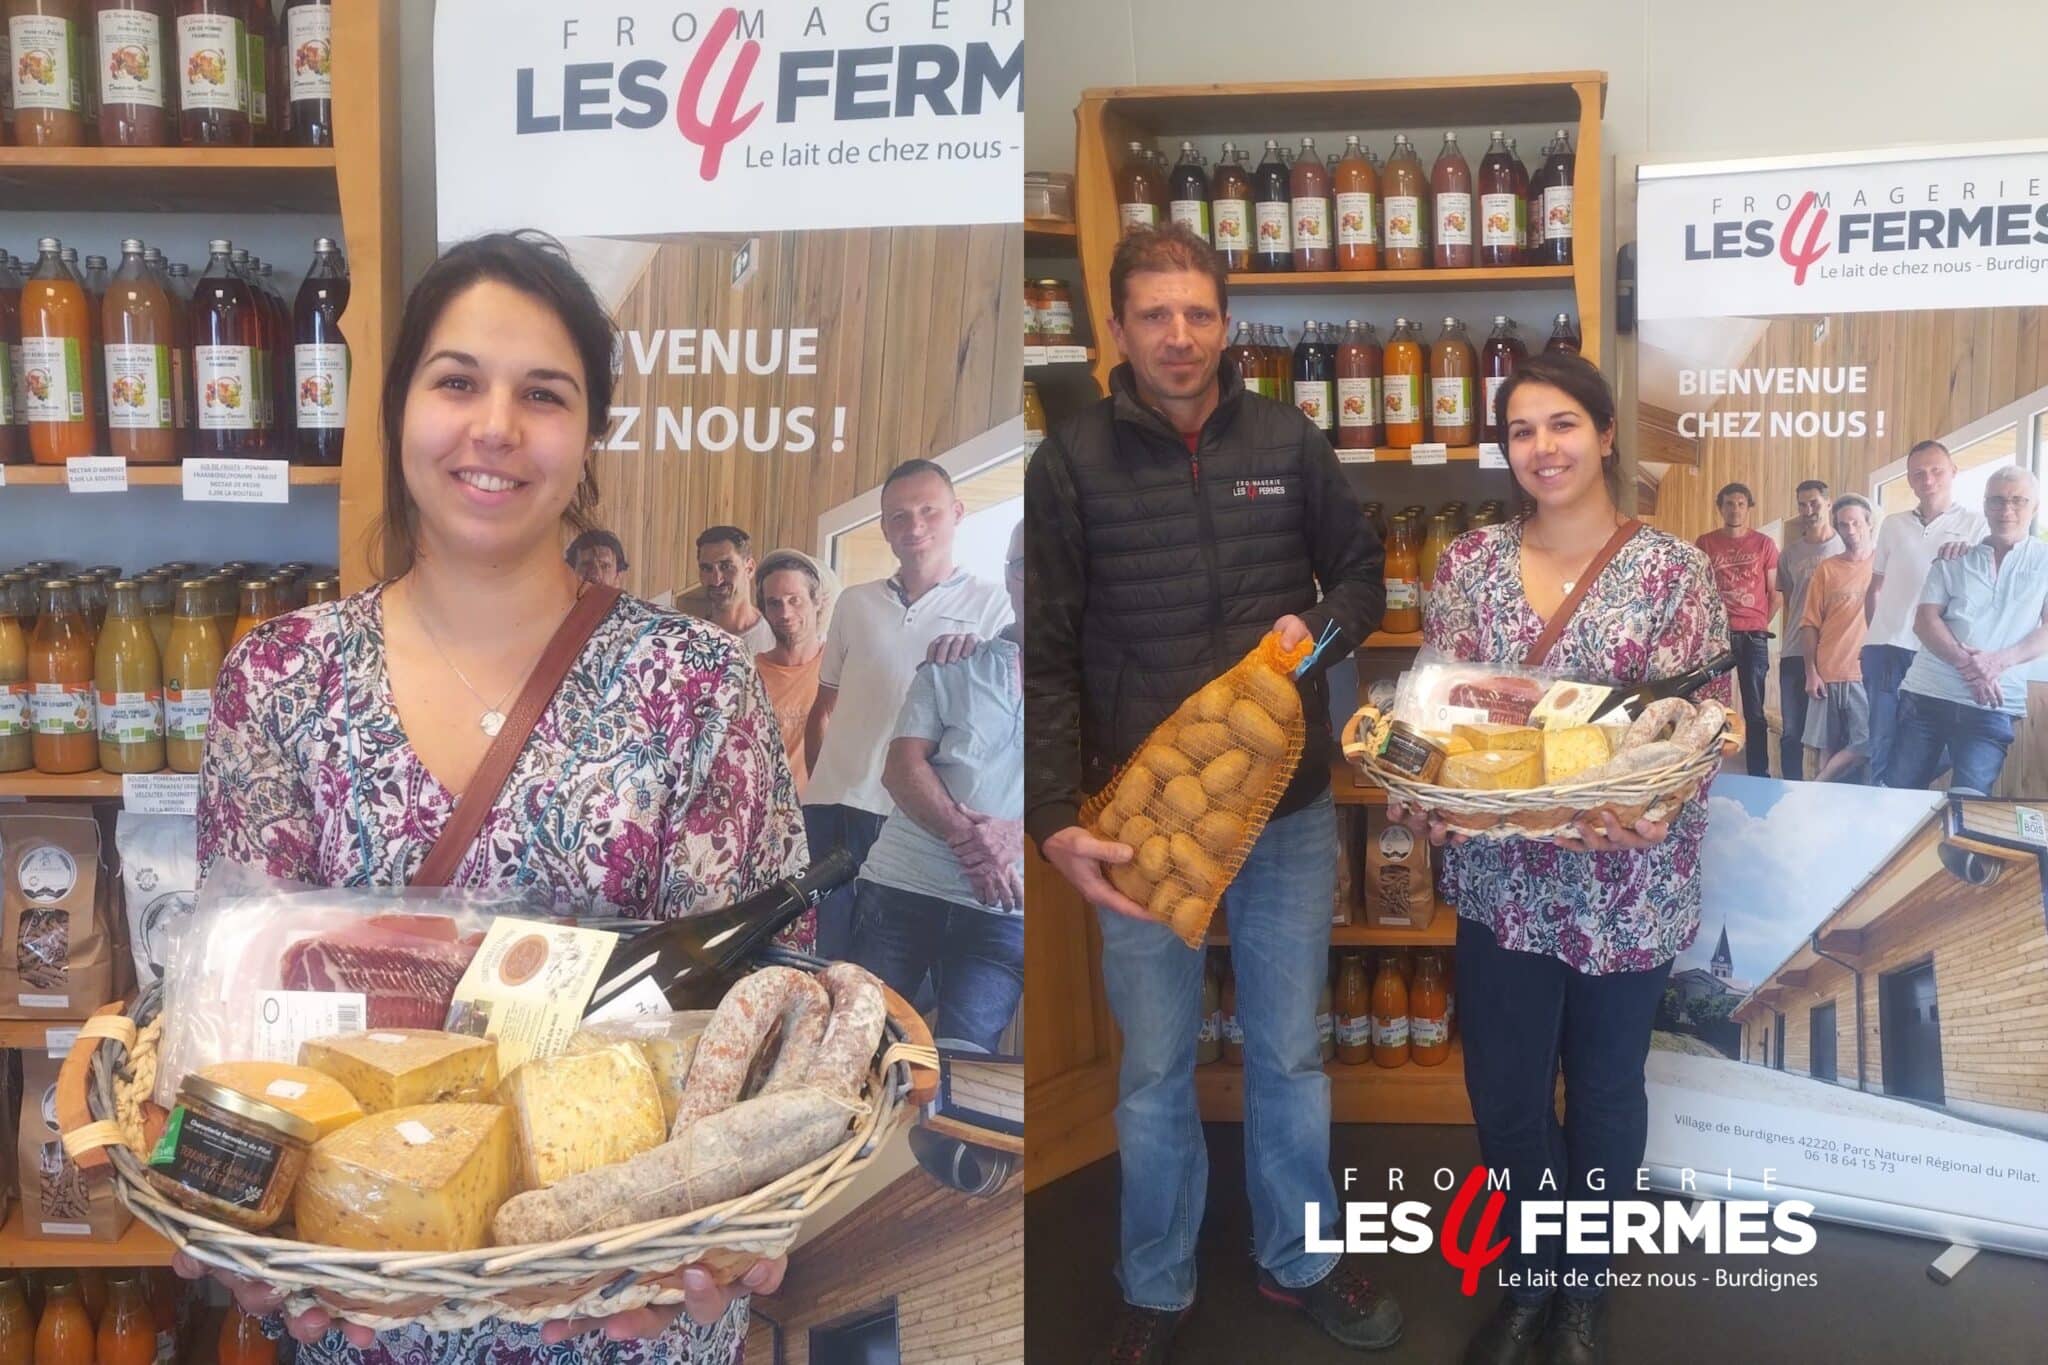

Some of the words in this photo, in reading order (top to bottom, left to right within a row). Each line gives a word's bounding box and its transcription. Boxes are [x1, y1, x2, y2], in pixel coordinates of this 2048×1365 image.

[516, 59, 668, 134] LES
[676, 7, 764, 181] 4
[746, 145, 774, 168] Le
[782, 142, 820, 167] lait
[828, 140, 859, 164] de
[868, 137, 929, 162] chez
[937, 140, 1002, 160] nous
[1713, 178, 2040, 215] FROMAGERIE
[1685, 219, 1775, 261] LES
[1779, 190, 1831, 286] 4
[1820, 265, 1838, 279] Le
[1842, 264, 1864, 278] lait
[1869, 262, 1888, 276] de
[1892, 260, 1929, 275] chez
[1934, 260, 1972, 273] nous
[611, 328, 818, 375] VENUE
[1678, 366, 1867, 396] BIENVENUE
[655, 406, 816, 452] NOUS
[1677, 411, 1761, 438] CHEZ
[1770, 410, 1867, 438] NOUS
[1674, 1113, 1712, 1132] Village
[1715, 1122, 1730, 1134] de
[1733, 1125, 1795, 1144] Burdignes
[1843, 1143, 1871, 1158] Parc
[1874, 1147, 1922, 1165] Naturel
[1926, 1155, 1982, 1175] Régional
[1985, 1164, 2004, 1178] du
[2007, 1168, 2041, 1184] Pilat.
[1804, 1149, 1821, 1161] 06
[1825, 1153, 1838, 1164] 18
[1842, 1155, 1857, 1167] 64
[1862, 1158, 1876, 1170] 15
[1881, 1162, 1895, 1173] 73
